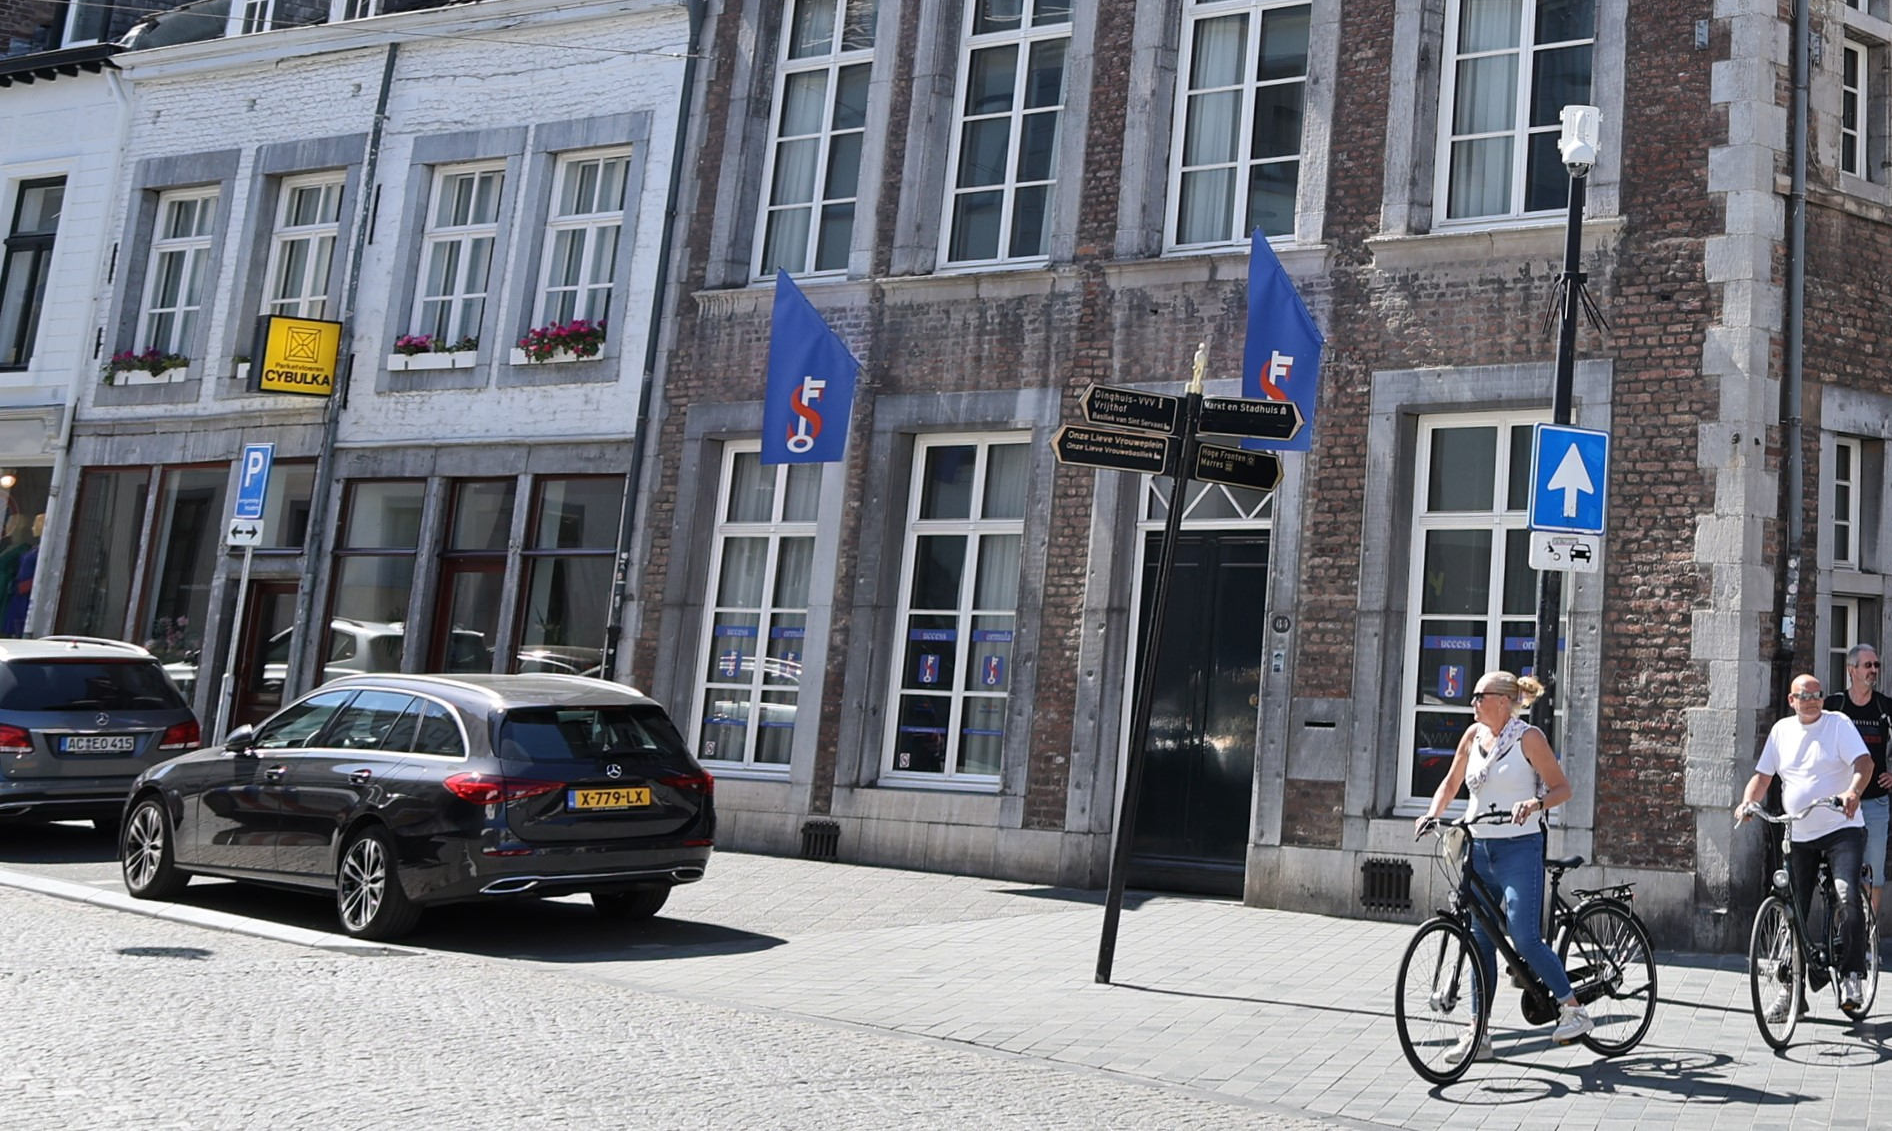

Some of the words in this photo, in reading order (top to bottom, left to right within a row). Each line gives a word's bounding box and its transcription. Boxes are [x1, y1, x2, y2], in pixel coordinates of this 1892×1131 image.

[265, 369, 330, 386] CYBULKA
[1094, 400, 1127, 413] Vrijthof
[1204, 400, 1225, 410] Markt
[1227, 403, 1237, 411] en
[1240, 403, 1278, 414] Stadhuis
[1092, 412, 1114, 422] Basiliek
[1128, 417, 1140, 425] Sint
[1066, 442, 1084, 450] Onze
[1085, 444, 1103, 452] Lieve
[1068, 431, 1089, 440] Onze
[1091, 433, 1113, 443] Lieve
[1115, 435, 1163, 449] Vrouweplein
[1220, 450, 1246, 462] Fronten
[244, 451, 264, 487] P
[581, 790, 643, 806] X-779-LX
